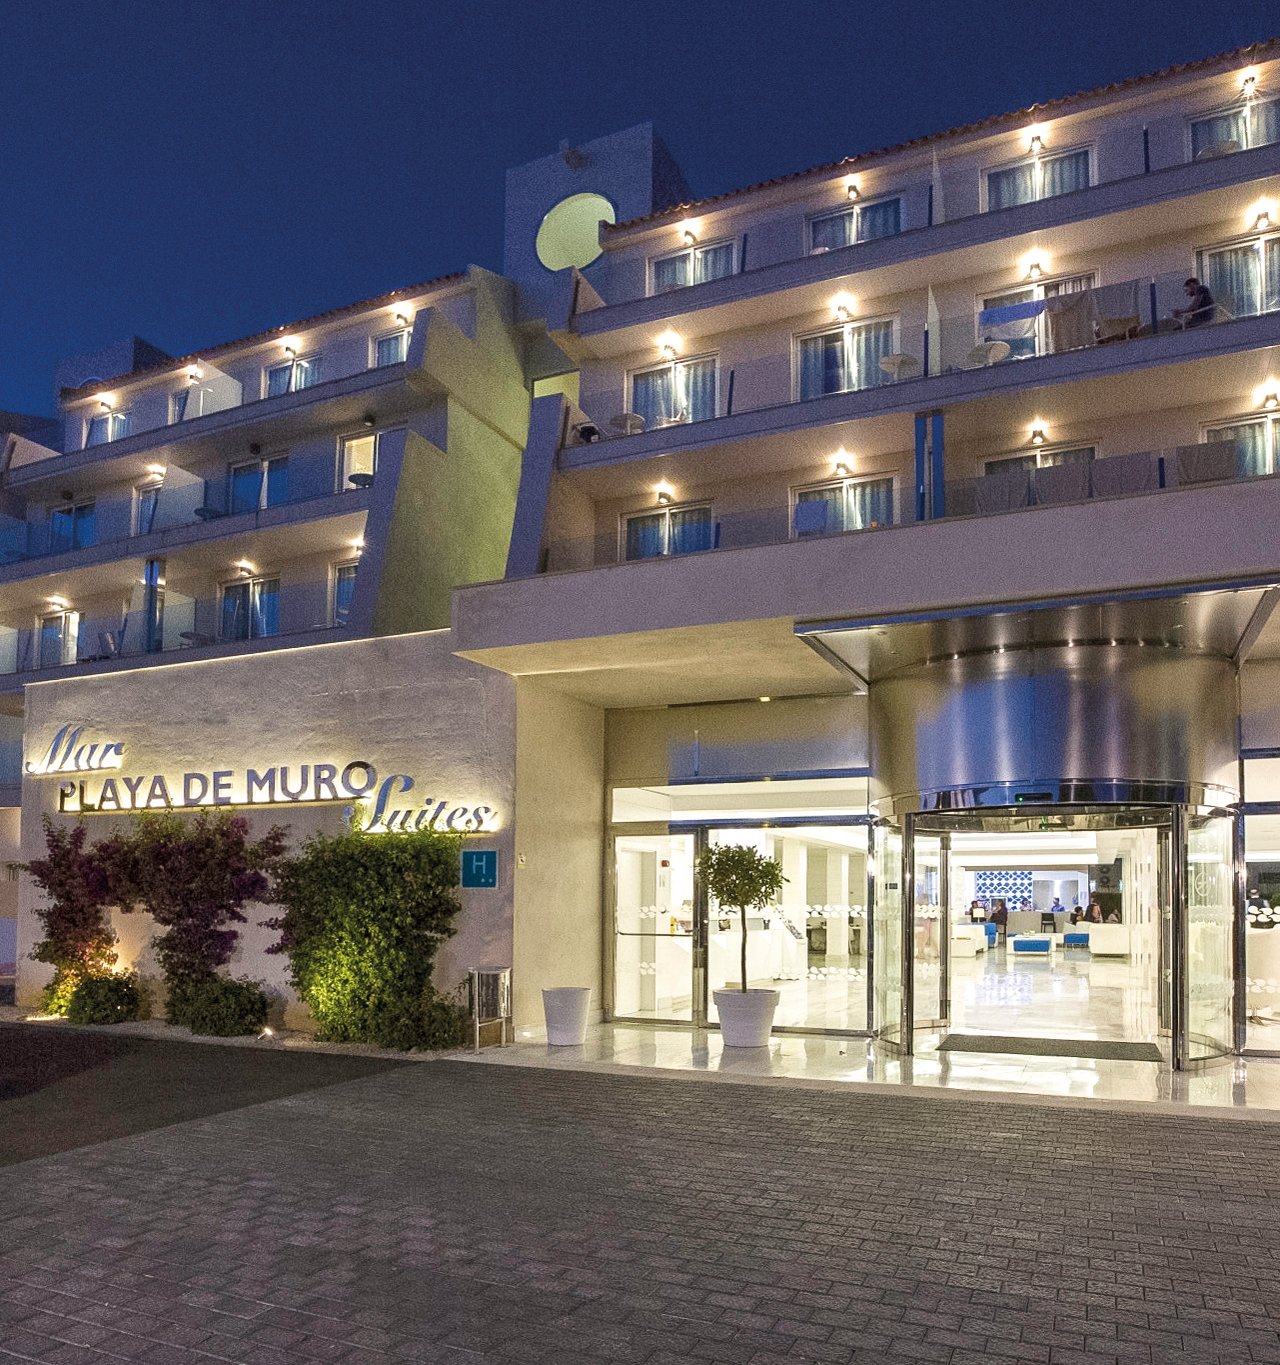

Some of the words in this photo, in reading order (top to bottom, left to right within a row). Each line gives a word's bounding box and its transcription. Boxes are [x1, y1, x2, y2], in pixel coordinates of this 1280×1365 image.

[25, 723, 126, 773] Mar
[59, 774, 173, 813] PLAYA
[183, 770, 235, 806] DE
[246, 760, 378, 803] MURO
[342, 774, 498, 834] Suites
[472, 854, 487, 876] H
